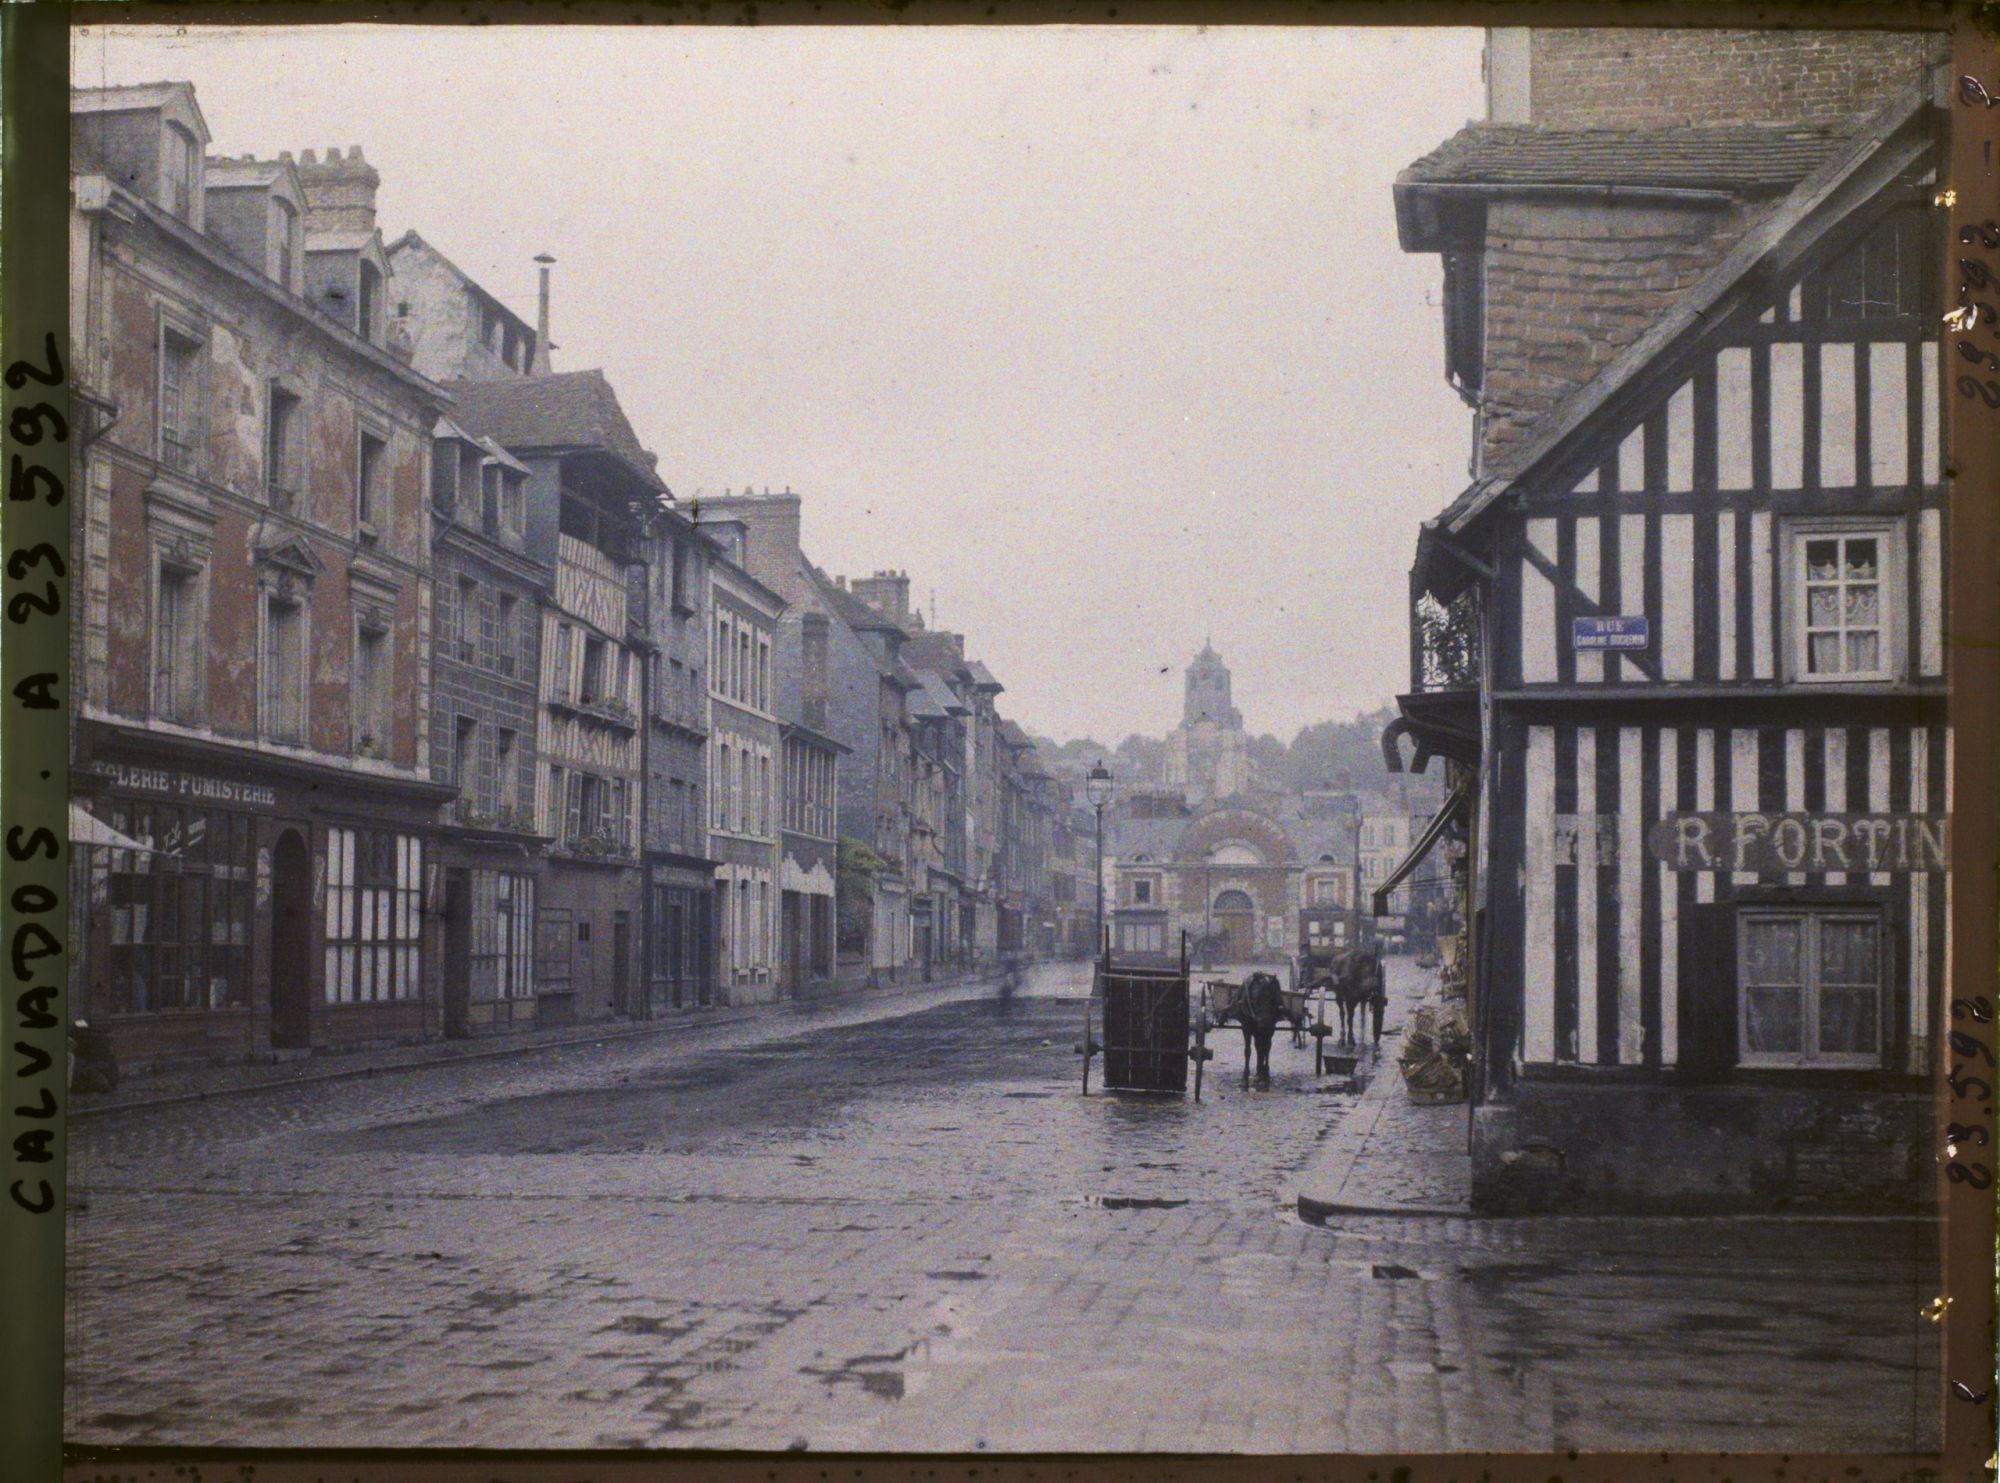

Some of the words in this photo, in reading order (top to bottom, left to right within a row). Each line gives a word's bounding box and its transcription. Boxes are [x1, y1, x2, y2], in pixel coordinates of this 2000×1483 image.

[5, 332, 68, 506] 592
[7, 542, 66, 624] 23
[1596, 619, 1624, 632] RUE
[13, 672, 60, 711] A
[178, 770, 275, 805] FUMISTERIE
[1675, 816, 1722, 868] R.
[1733, 812, 1948, 872] FORTIN
[6, 825, 62, 1214] CALVADOS
